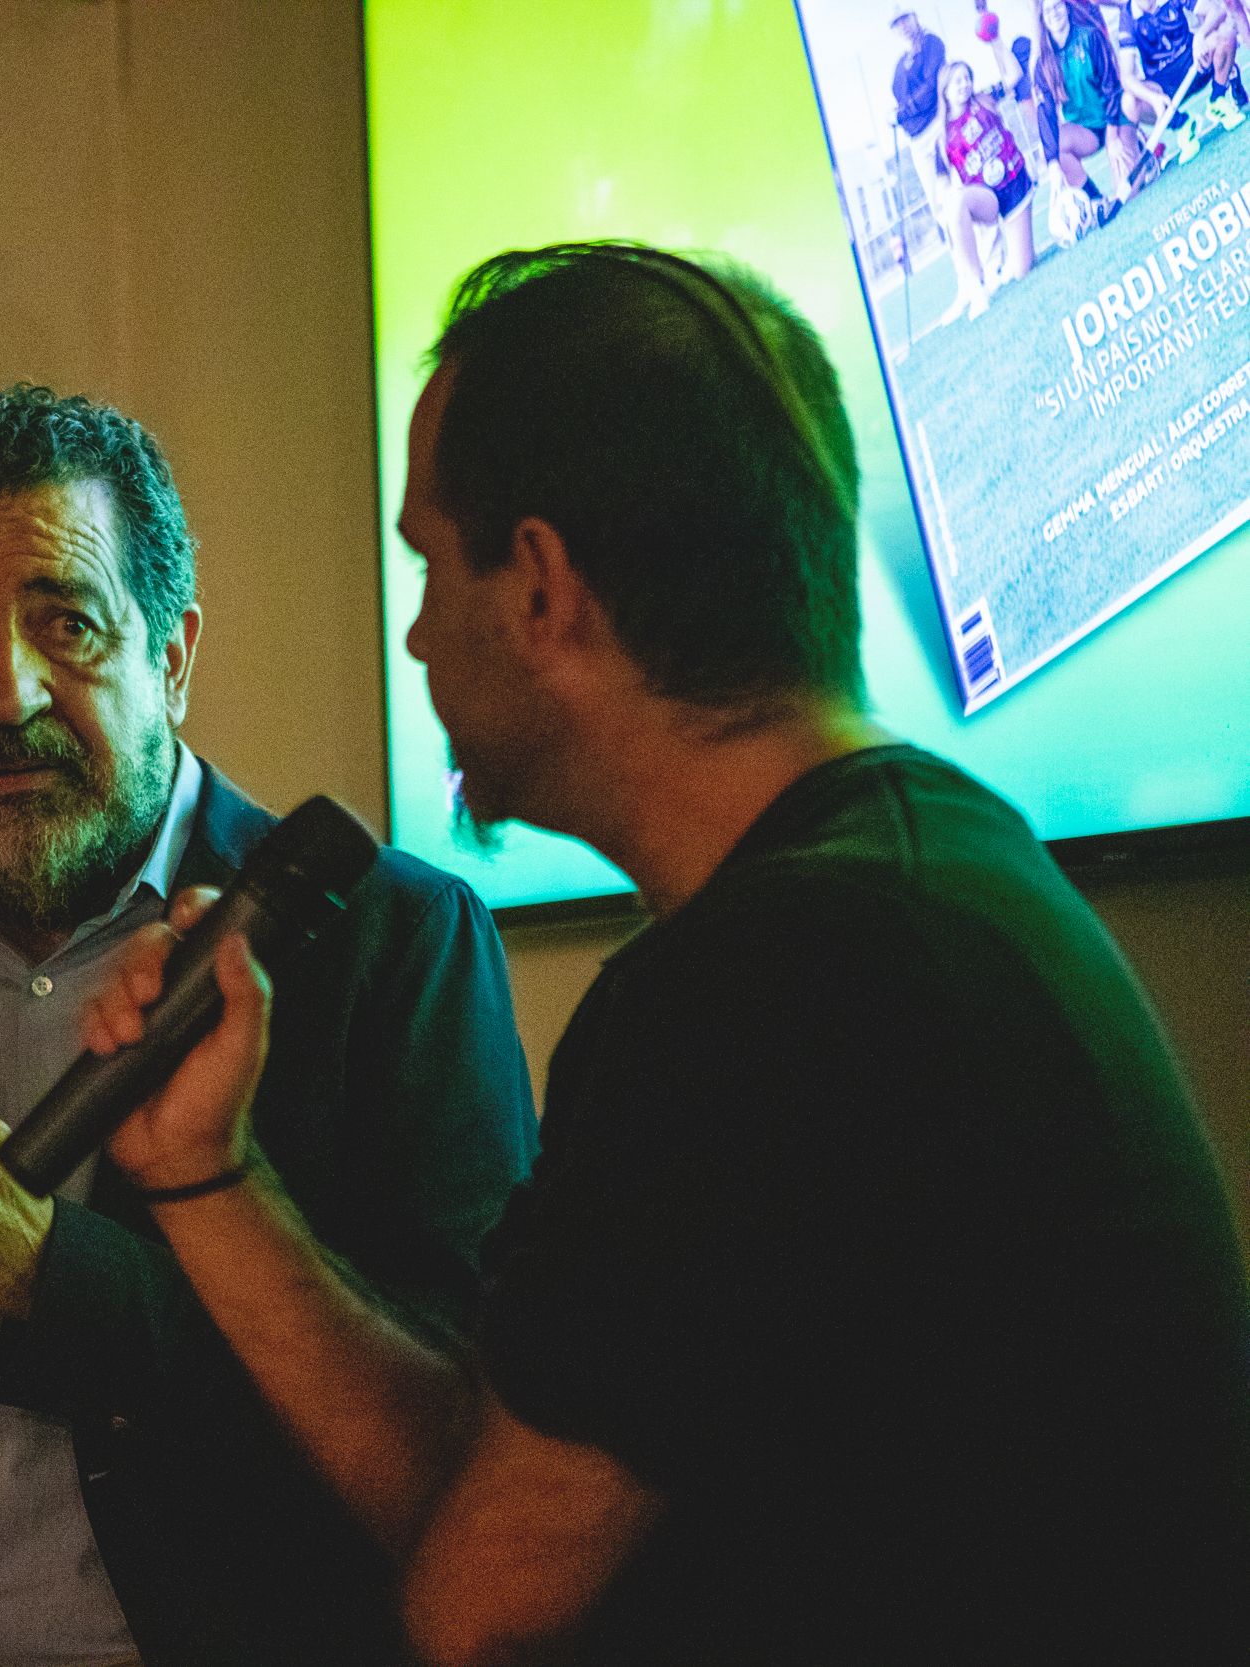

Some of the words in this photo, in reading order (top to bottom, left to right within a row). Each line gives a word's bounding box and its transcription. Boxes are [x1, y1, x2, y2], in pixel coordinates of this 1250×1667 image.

[1152, 183, 1223, 242] ENTREVISTA
[1061, 253, 1167, 366] JORDI
[1064, 359, 1098, 400] UN
[1141, 305, 1172, 343] NO
[1197, 238, 1250, 298] CLAR
[1088, 315, 1208, 420] IMPORTANT,
[1231, 275, 1250, 307] U
[1043, 490, 1097, 543] GEMMA
[1095, 437, 1162, 500] MENGUAL
[1167, 403, 1204, 443] ALEX
[1109, 465, 1164, 522] ESBART
[1170, 398, 1250, 471] ORQUESTRA
